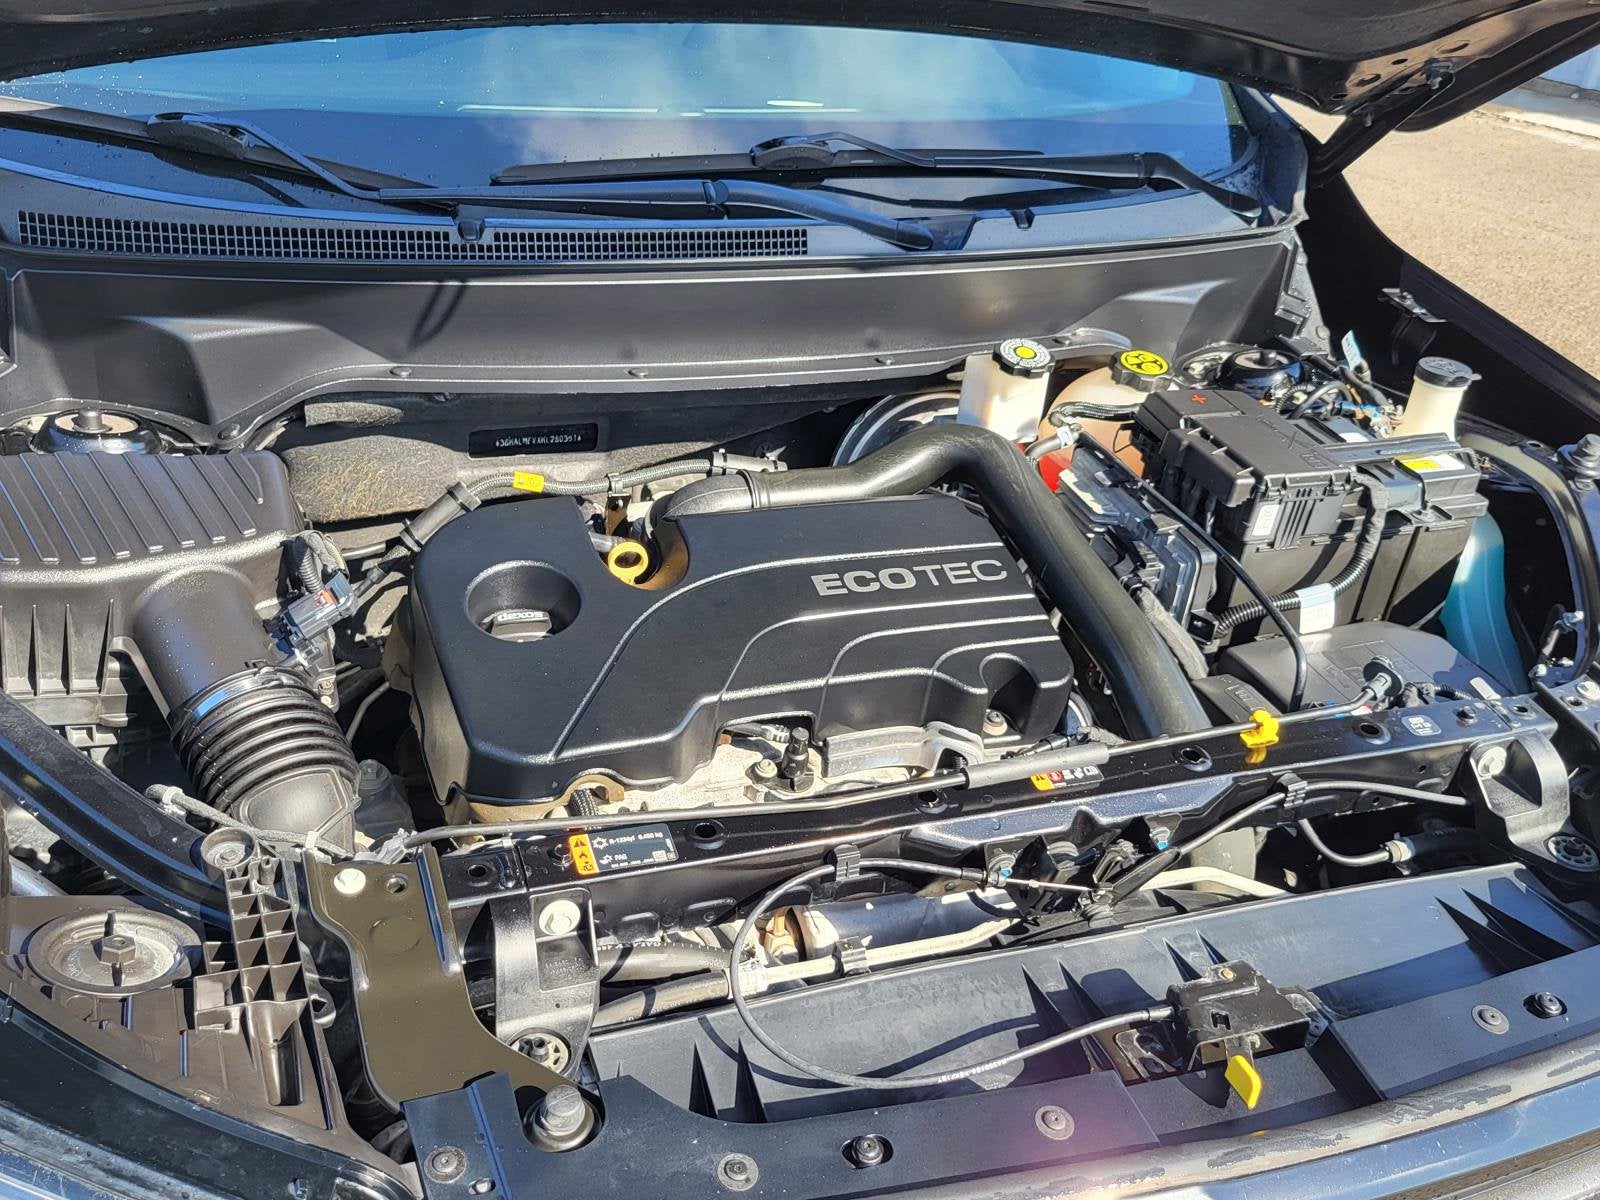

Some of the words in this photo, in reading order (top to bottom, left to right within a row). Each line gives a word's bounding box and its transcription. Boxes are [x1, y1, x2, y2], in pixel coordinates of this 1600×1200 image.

[810, 559, 1008, 597] ECOTEC
[497, 611, 543, 621] dexos
[614, 853, 628, 861] PAG
